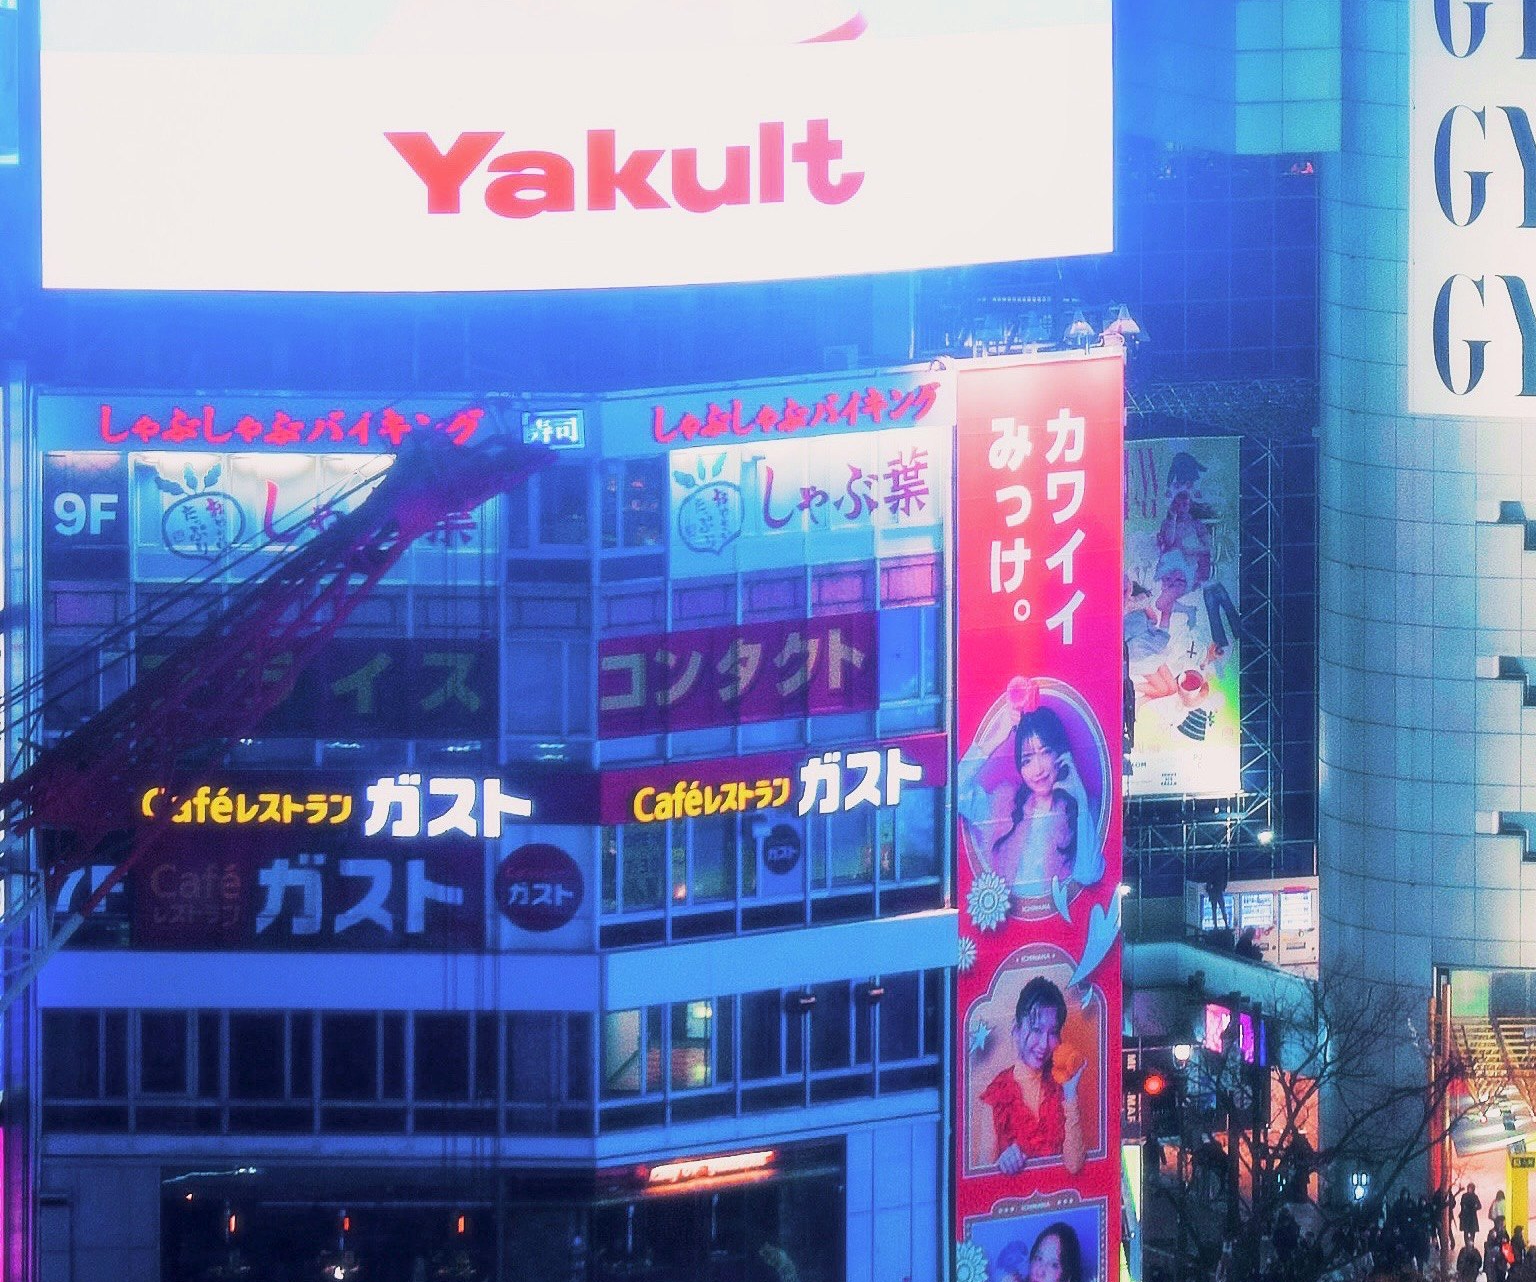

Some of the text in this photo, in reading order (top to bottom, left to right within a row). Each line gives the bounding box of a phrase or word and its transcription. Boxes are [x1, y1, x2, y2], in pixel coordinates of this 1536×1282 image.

[383, 118, 865, 219] Yakult
[652, 382, 938, 441] しゃぶしゃぶバイキング
[53, 493, 119, 536] 9F
[762, 448, 928, 529] しゃぶ葉
[1045, 409, 1086, 644] カワイイ
[602, 627, 864, 711] コンタクト
[365, 774, 533, 837] ガスト
[797, 748, 922, 816] ガスト
[256, 853, 464, 934] ガスト
[508, 882, 574, 906] ガスト
